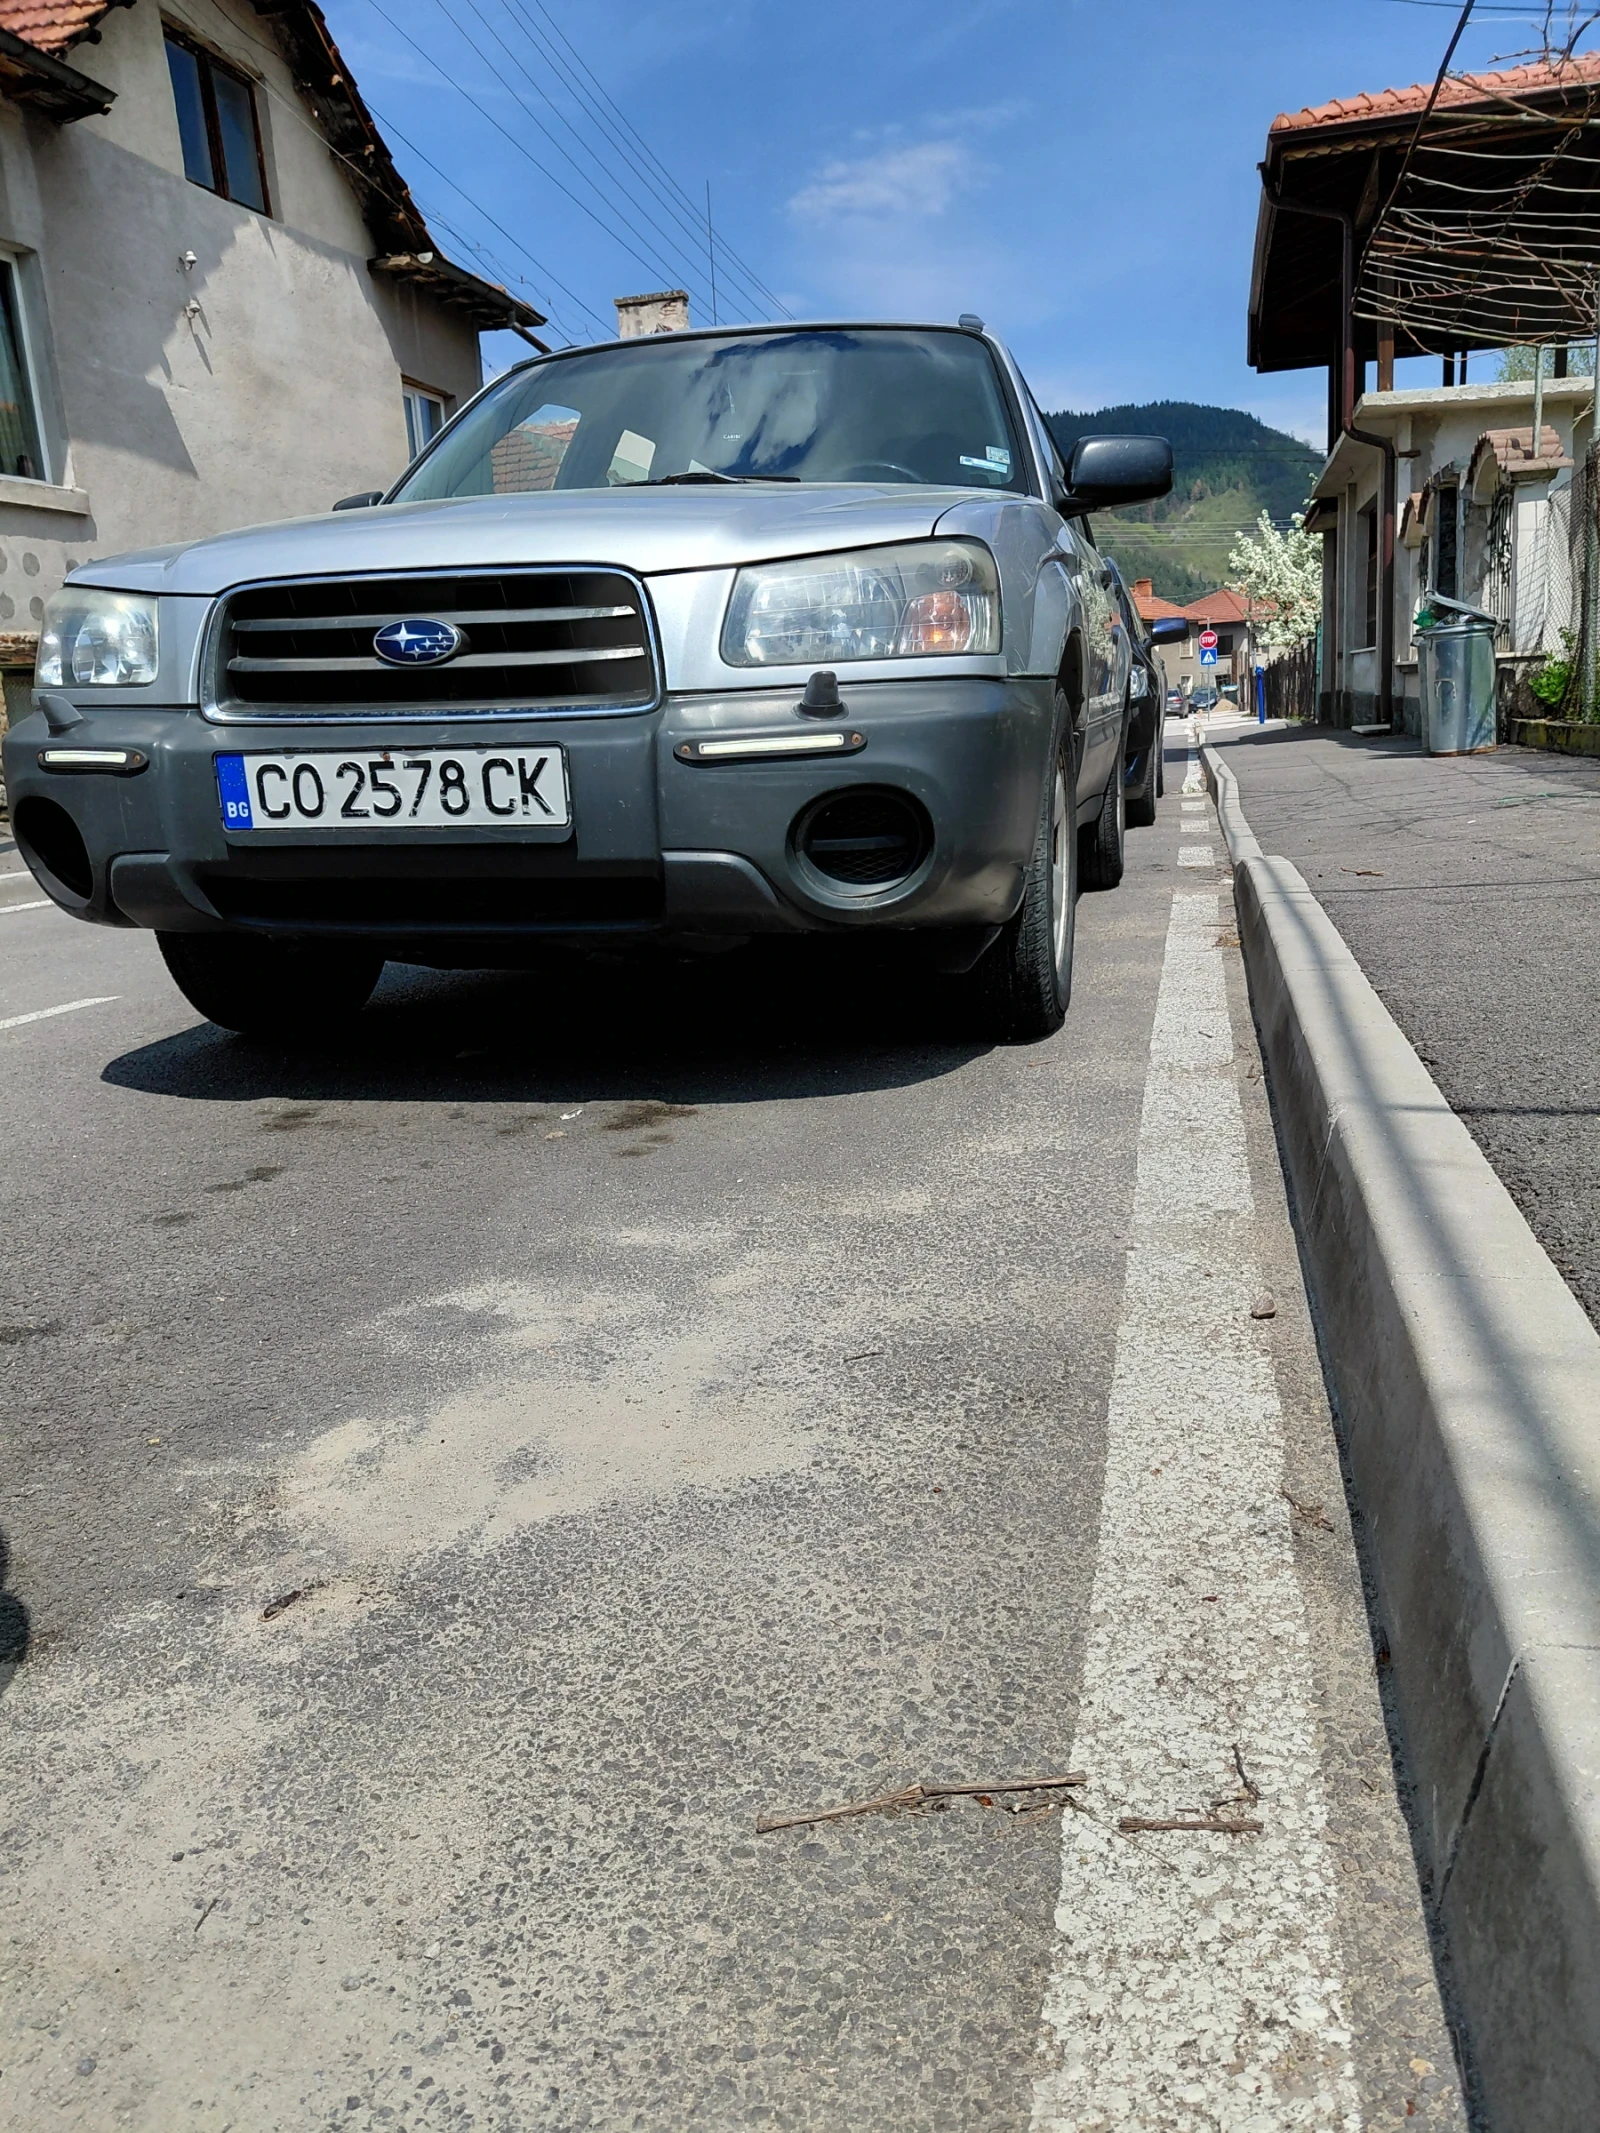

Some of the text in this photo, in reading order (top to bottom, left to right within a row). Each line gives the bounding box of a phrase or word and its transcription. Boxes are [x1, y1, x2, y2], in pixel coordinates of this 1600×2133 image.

[1201, 636, 1216, 644] STOP
[335, 758, 471, 818] 2578
[480, 755, 556, 817] CK
[226, 801, 249, 818] BG
